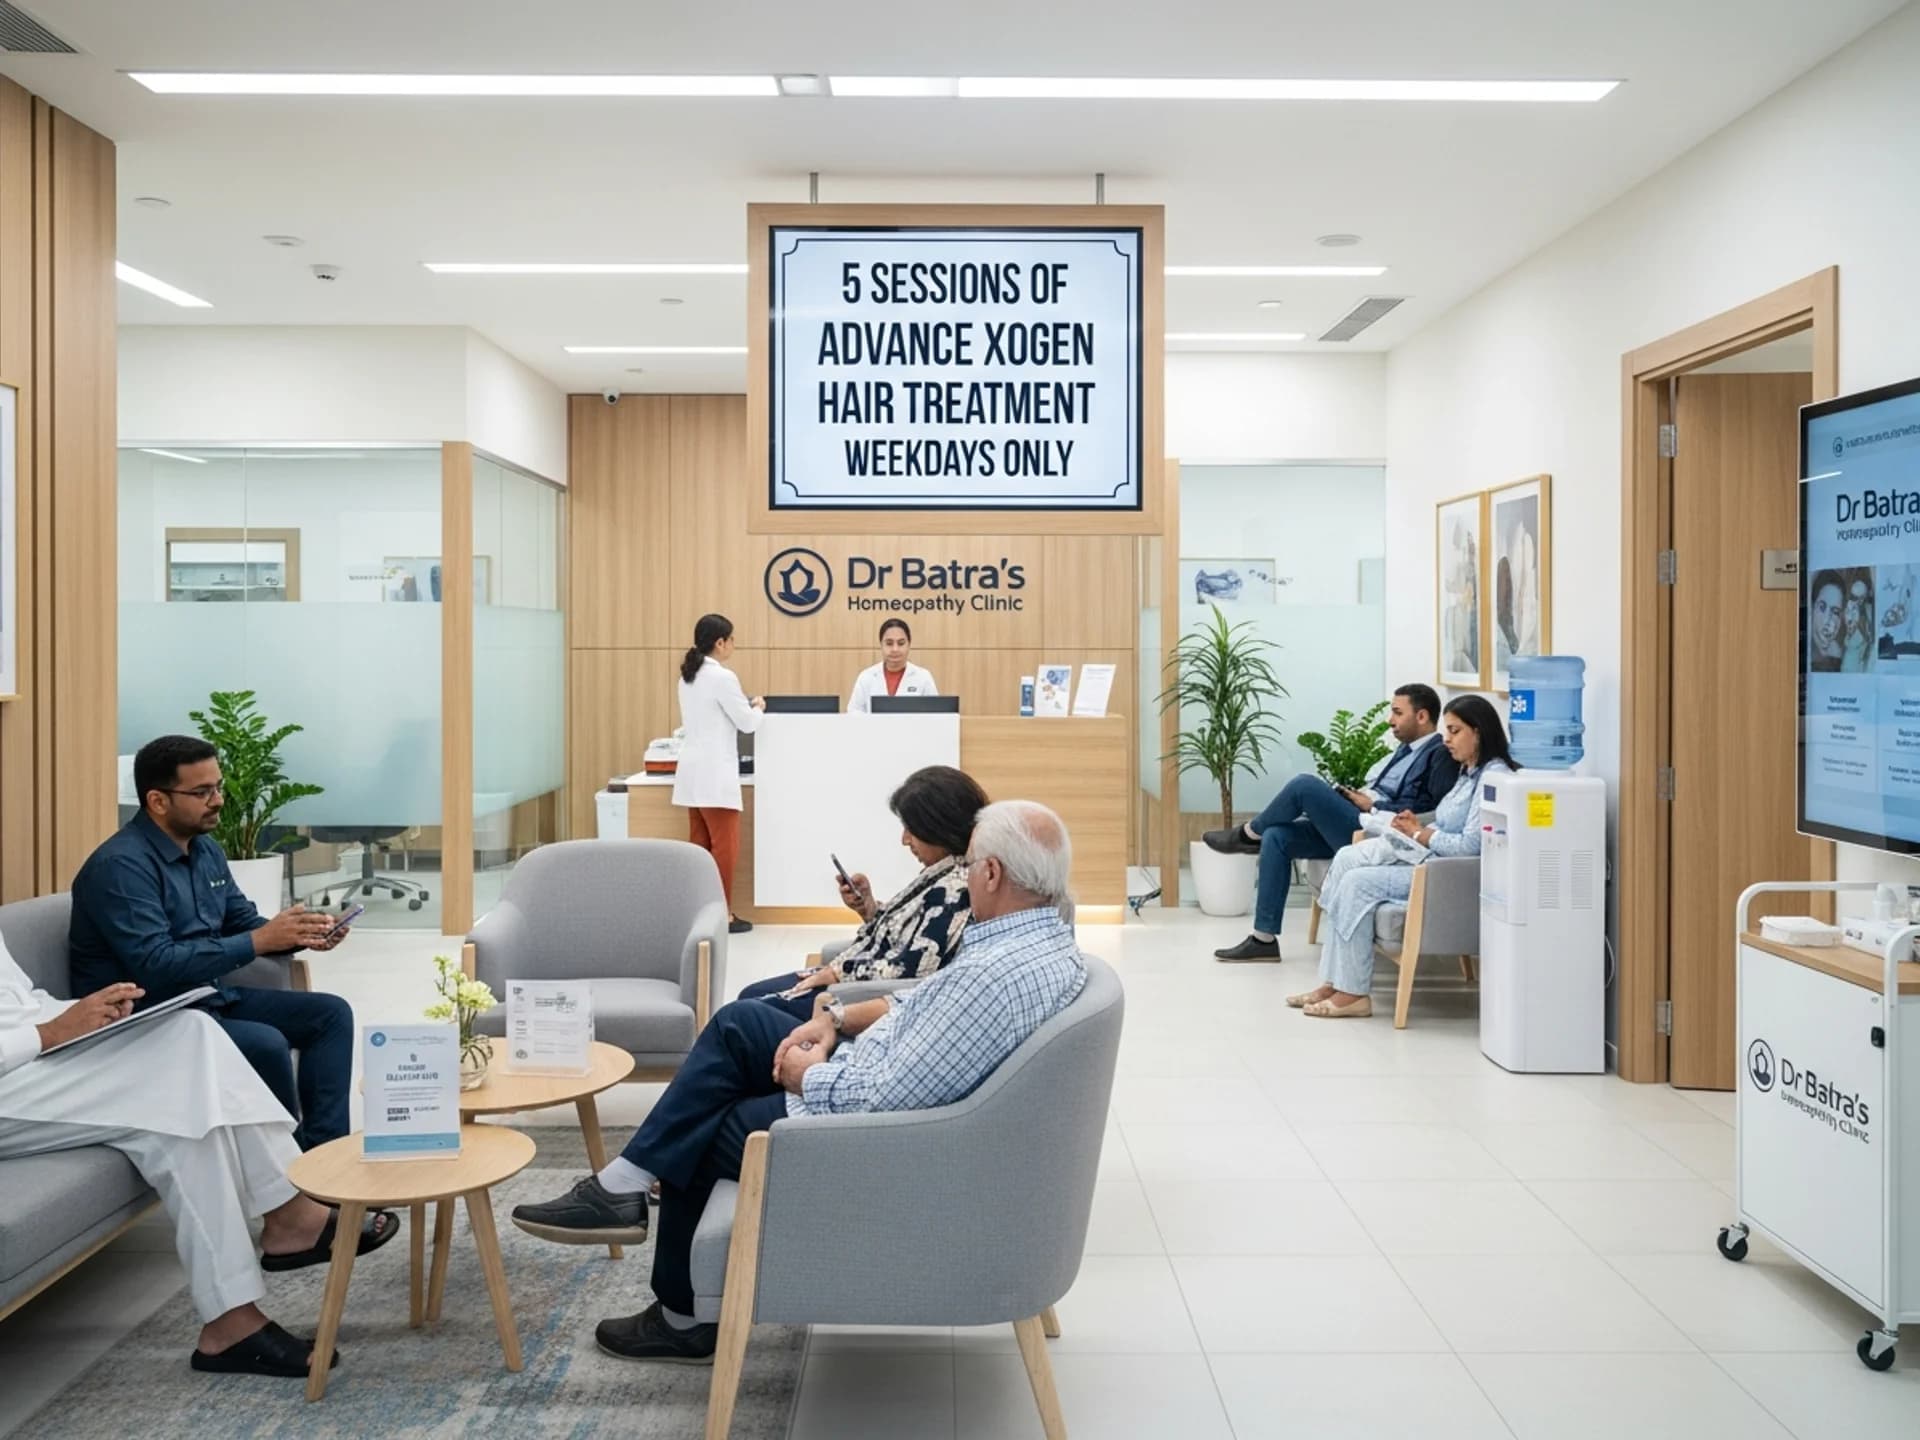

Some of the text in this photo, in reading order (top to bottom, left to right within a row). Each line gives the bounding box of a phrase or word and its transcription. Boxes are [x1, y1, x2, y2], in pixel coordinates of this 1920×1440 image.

[842, 262, 1069, 305] 5 SESSIONS OF
[817, 321, 1094, 367] ADVANCE XOGEN
[818, 381, 1096, 425] HAIR TREATMENT
[844, 438, 1074, 477] WEEKDAYS ONLY
[1836, 488, 1920, 523] Dr Batra
[848, 557, 1026, 590] Dr Batra's
[970, 594, 1023, 611] Clinic
[1781, 1058, 1803, 1091] Dr
[1805, 1070, 1870, 1126] Batra's
